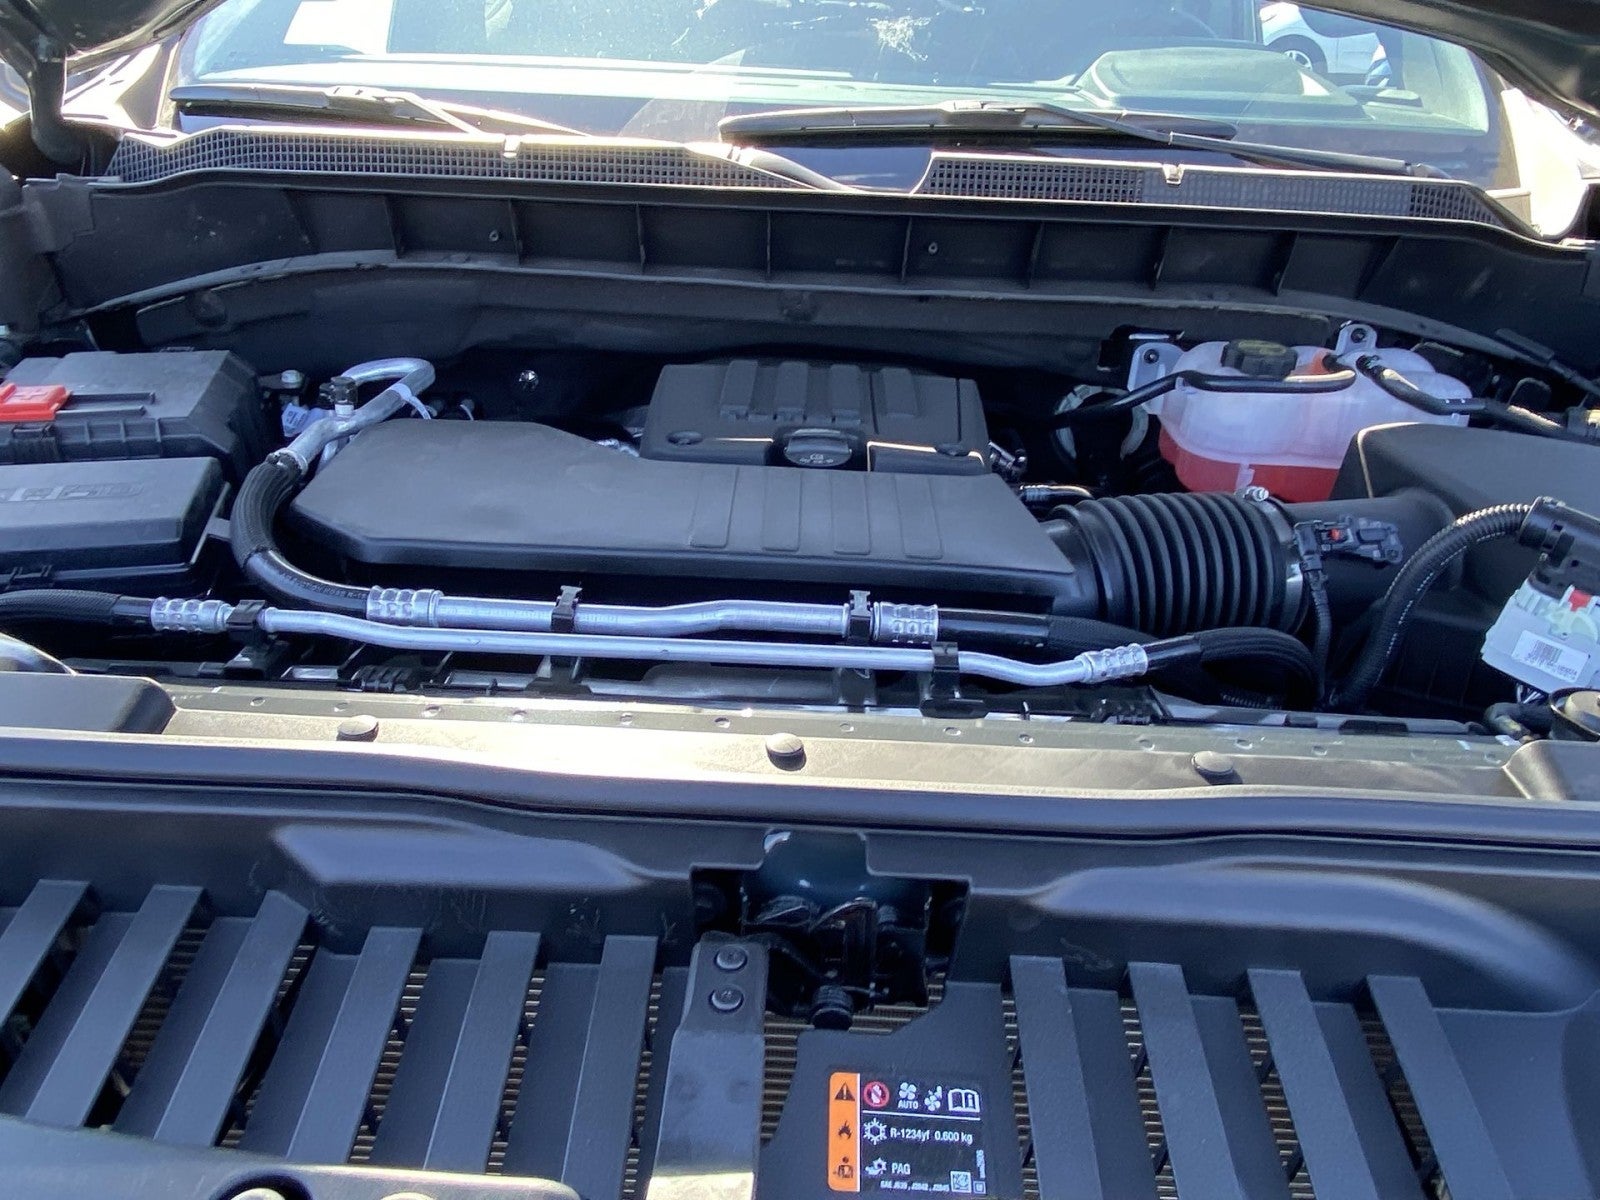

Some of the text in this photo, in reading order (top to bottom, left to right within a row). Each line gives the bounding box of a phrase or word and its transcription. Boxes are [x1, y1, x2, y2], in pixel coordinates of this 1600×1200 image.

[898, 1100, 918, 1109] AUTO
[890, 1129, 973, 1145] R-1234yf 0.600 kg
[892, 1163, 910, 1174] PAG
